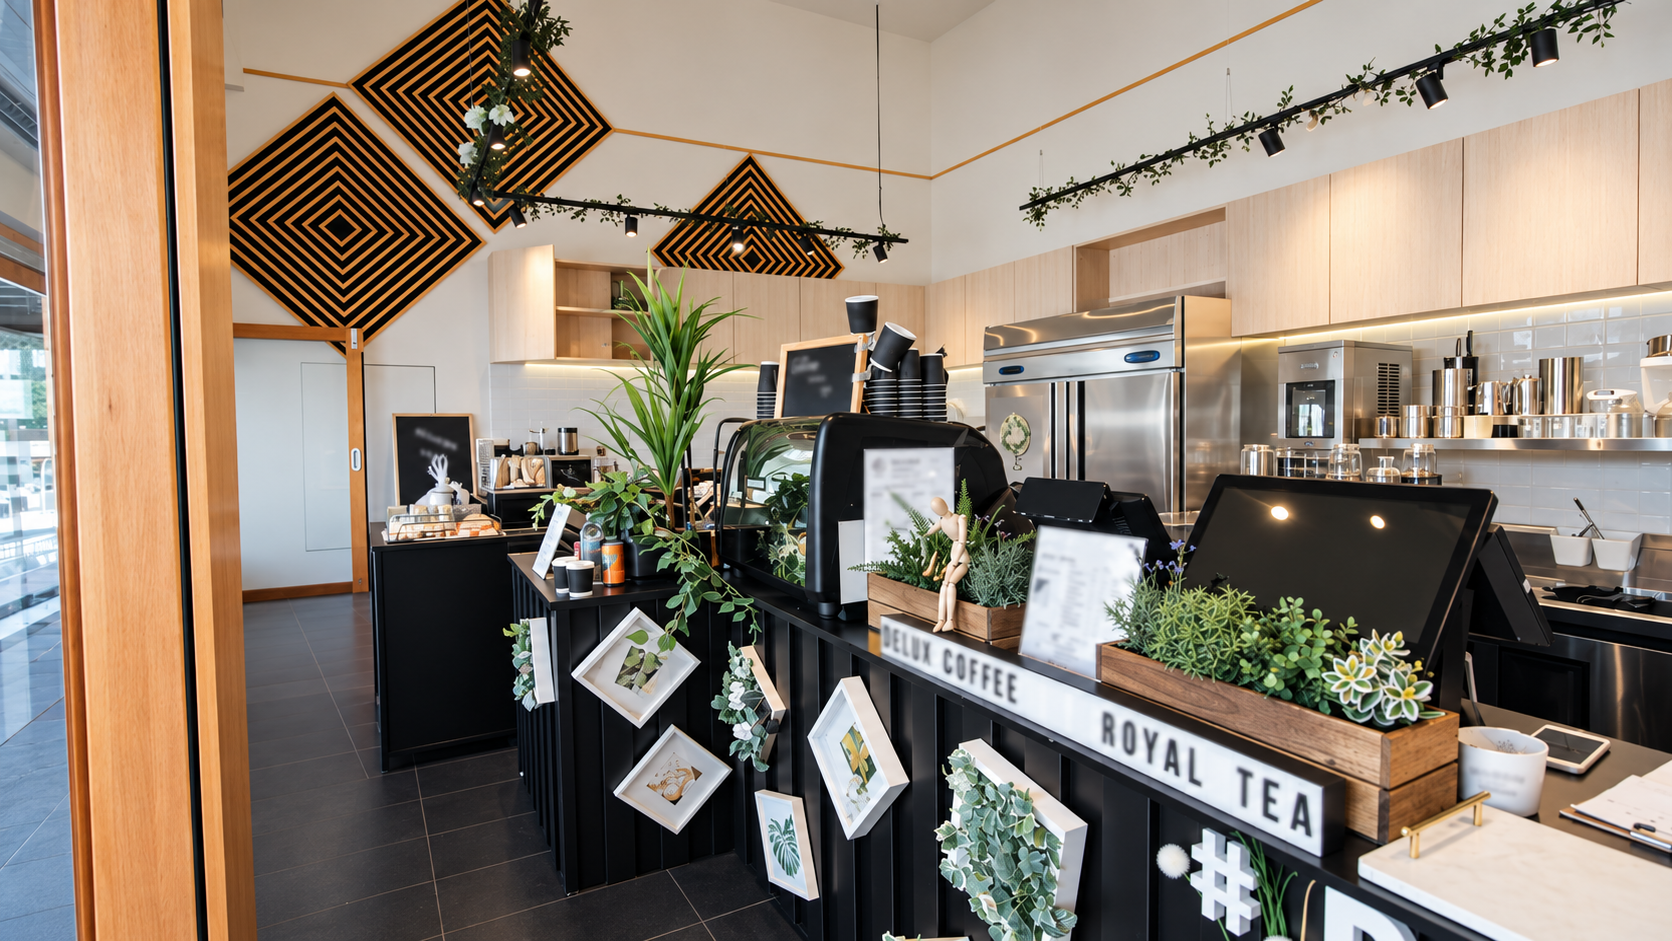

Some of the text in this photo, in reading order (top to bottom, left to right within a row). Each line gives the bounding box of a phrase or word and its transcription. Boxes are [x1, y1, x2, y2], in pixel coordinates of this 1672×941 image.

[883, 624, 1312, 837] DELUX COFFEE ROYAL TEA
